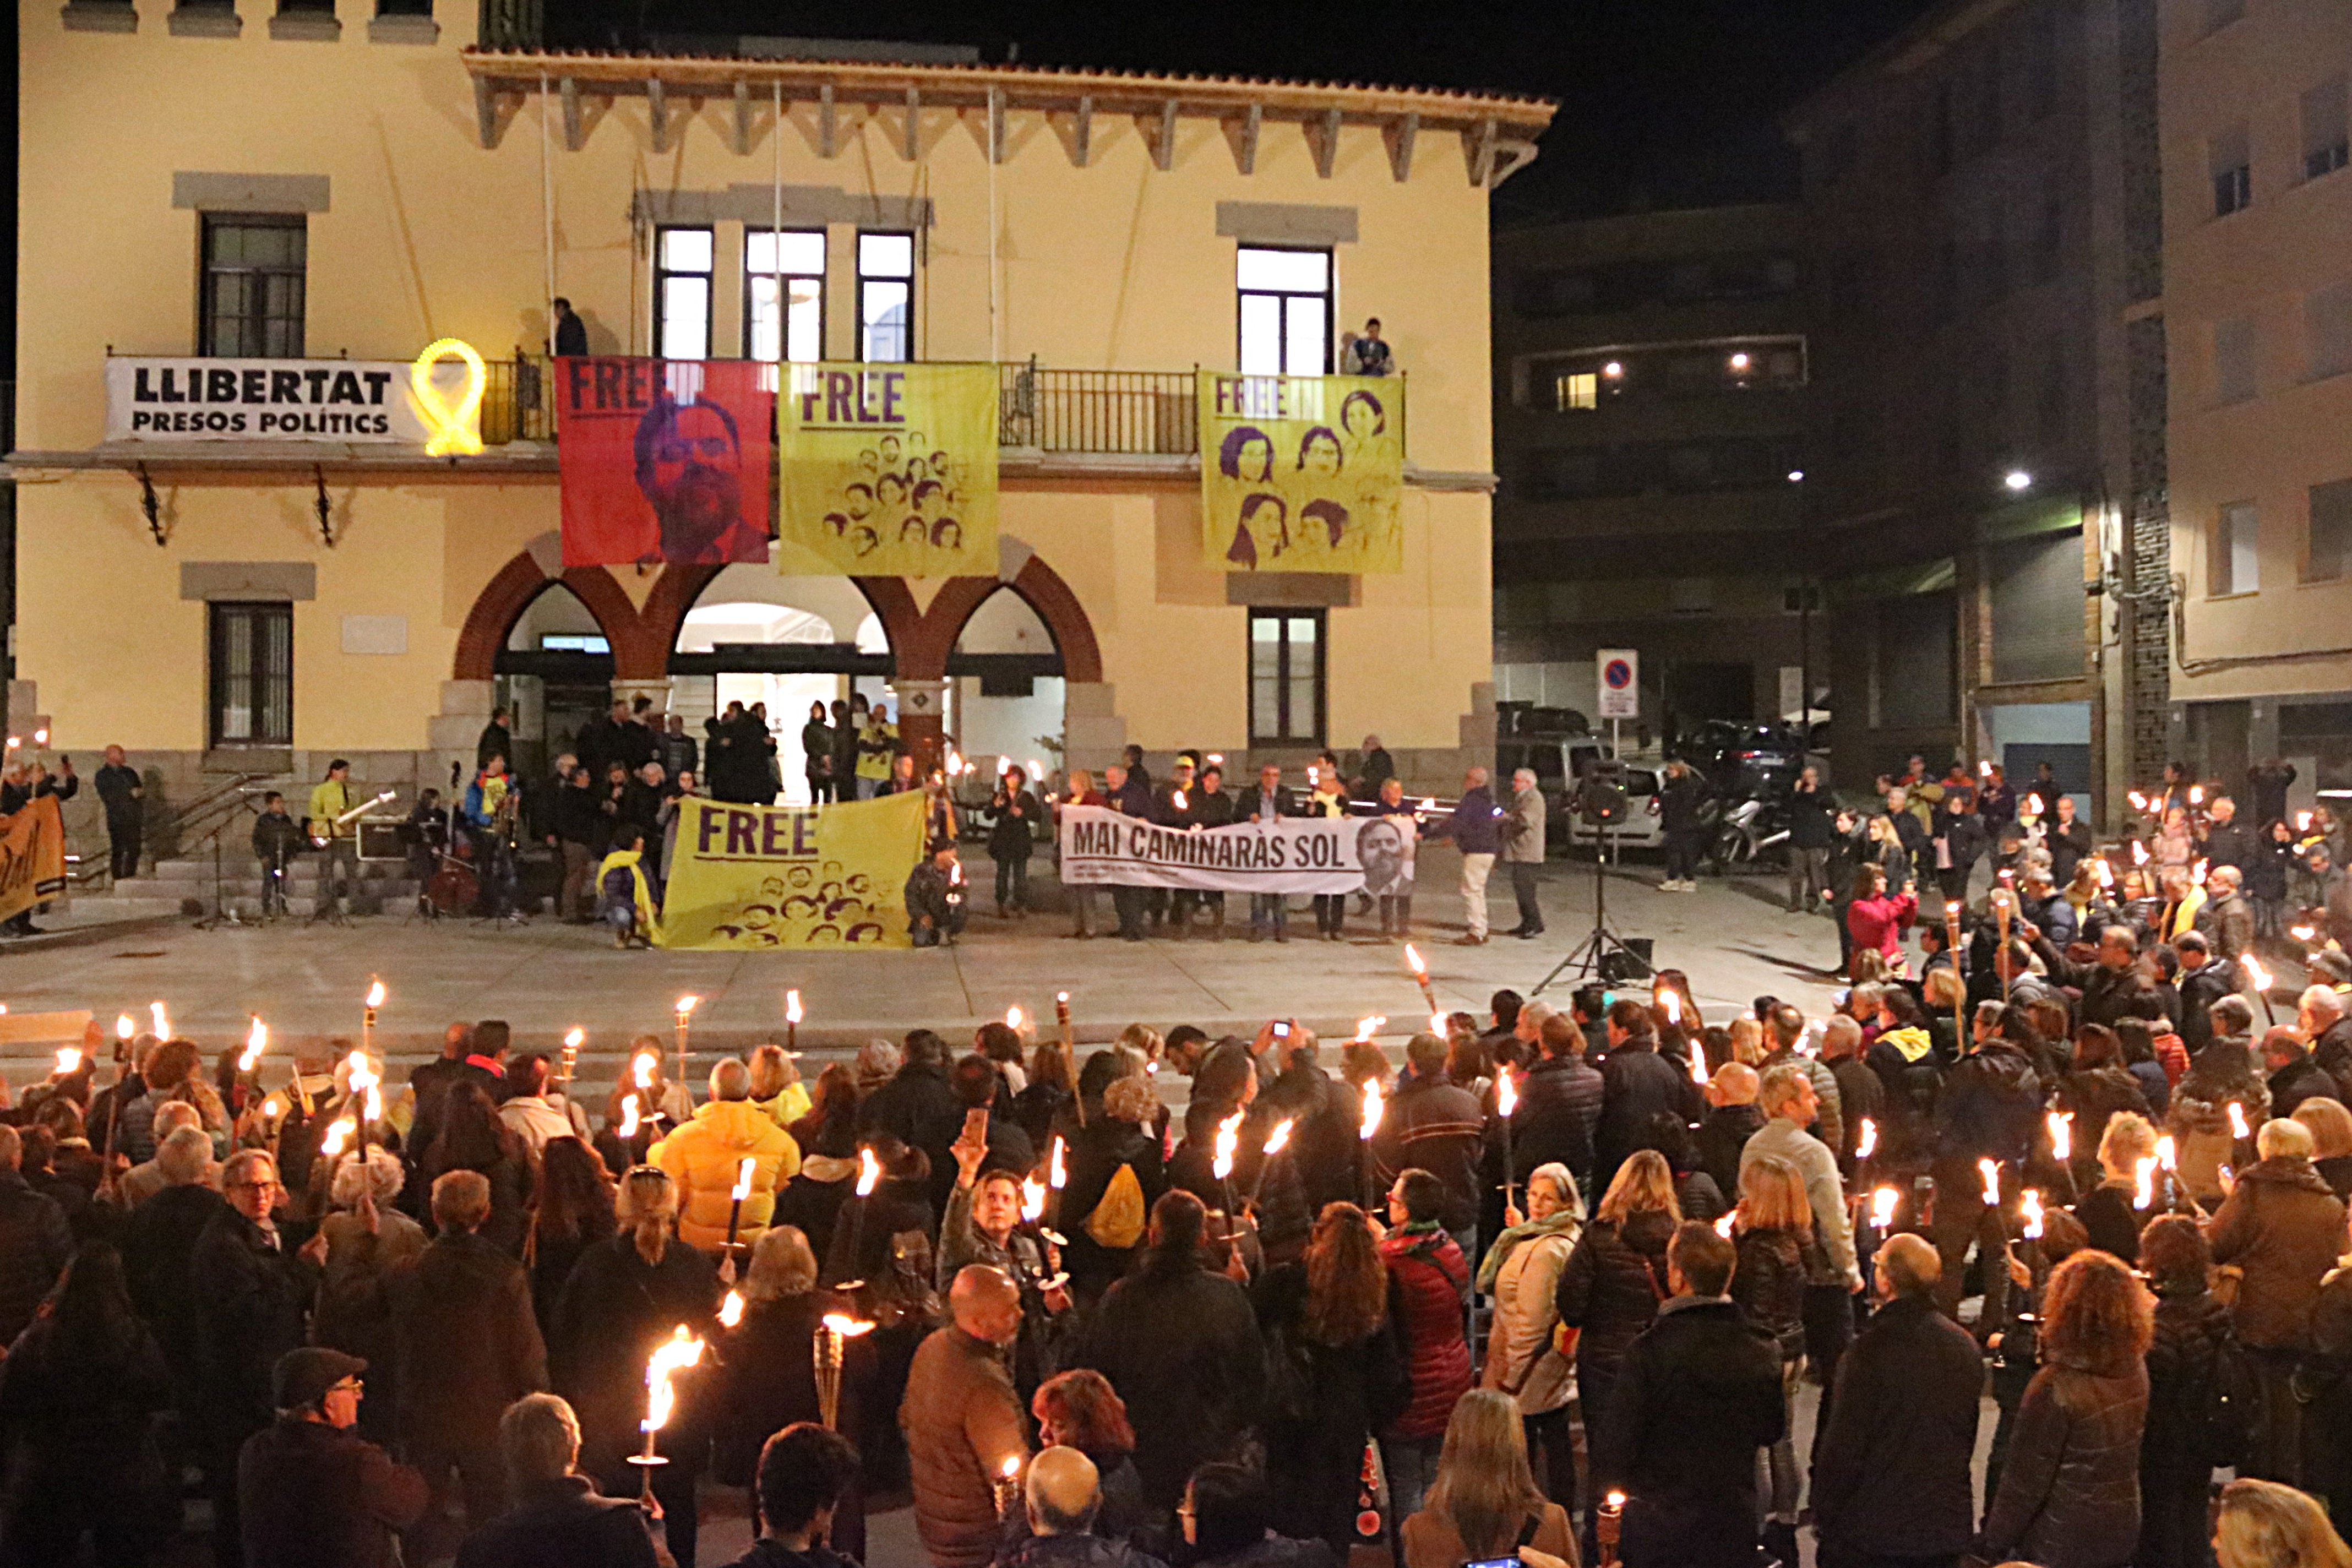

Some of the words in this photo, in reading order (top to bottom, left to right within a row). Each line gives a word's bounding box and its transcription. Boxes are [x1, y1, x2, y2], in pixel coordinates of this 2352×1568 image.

[135, 368, 391, 404] LLIBERTAT
[803, 371, 905, 422] FREE
[1216, 377, 1287, 415] FREE
[132, 410, 247, 431] PRESOS
[259, 407, 389, 433] POLÍTICS
[698, 805, 818, 854] FREE
[1074, 822, 1119, 855] MAI
[1130, 825, 1286, 868] CAMINARÀS
[1294, 834, 1344, 867] SOL
